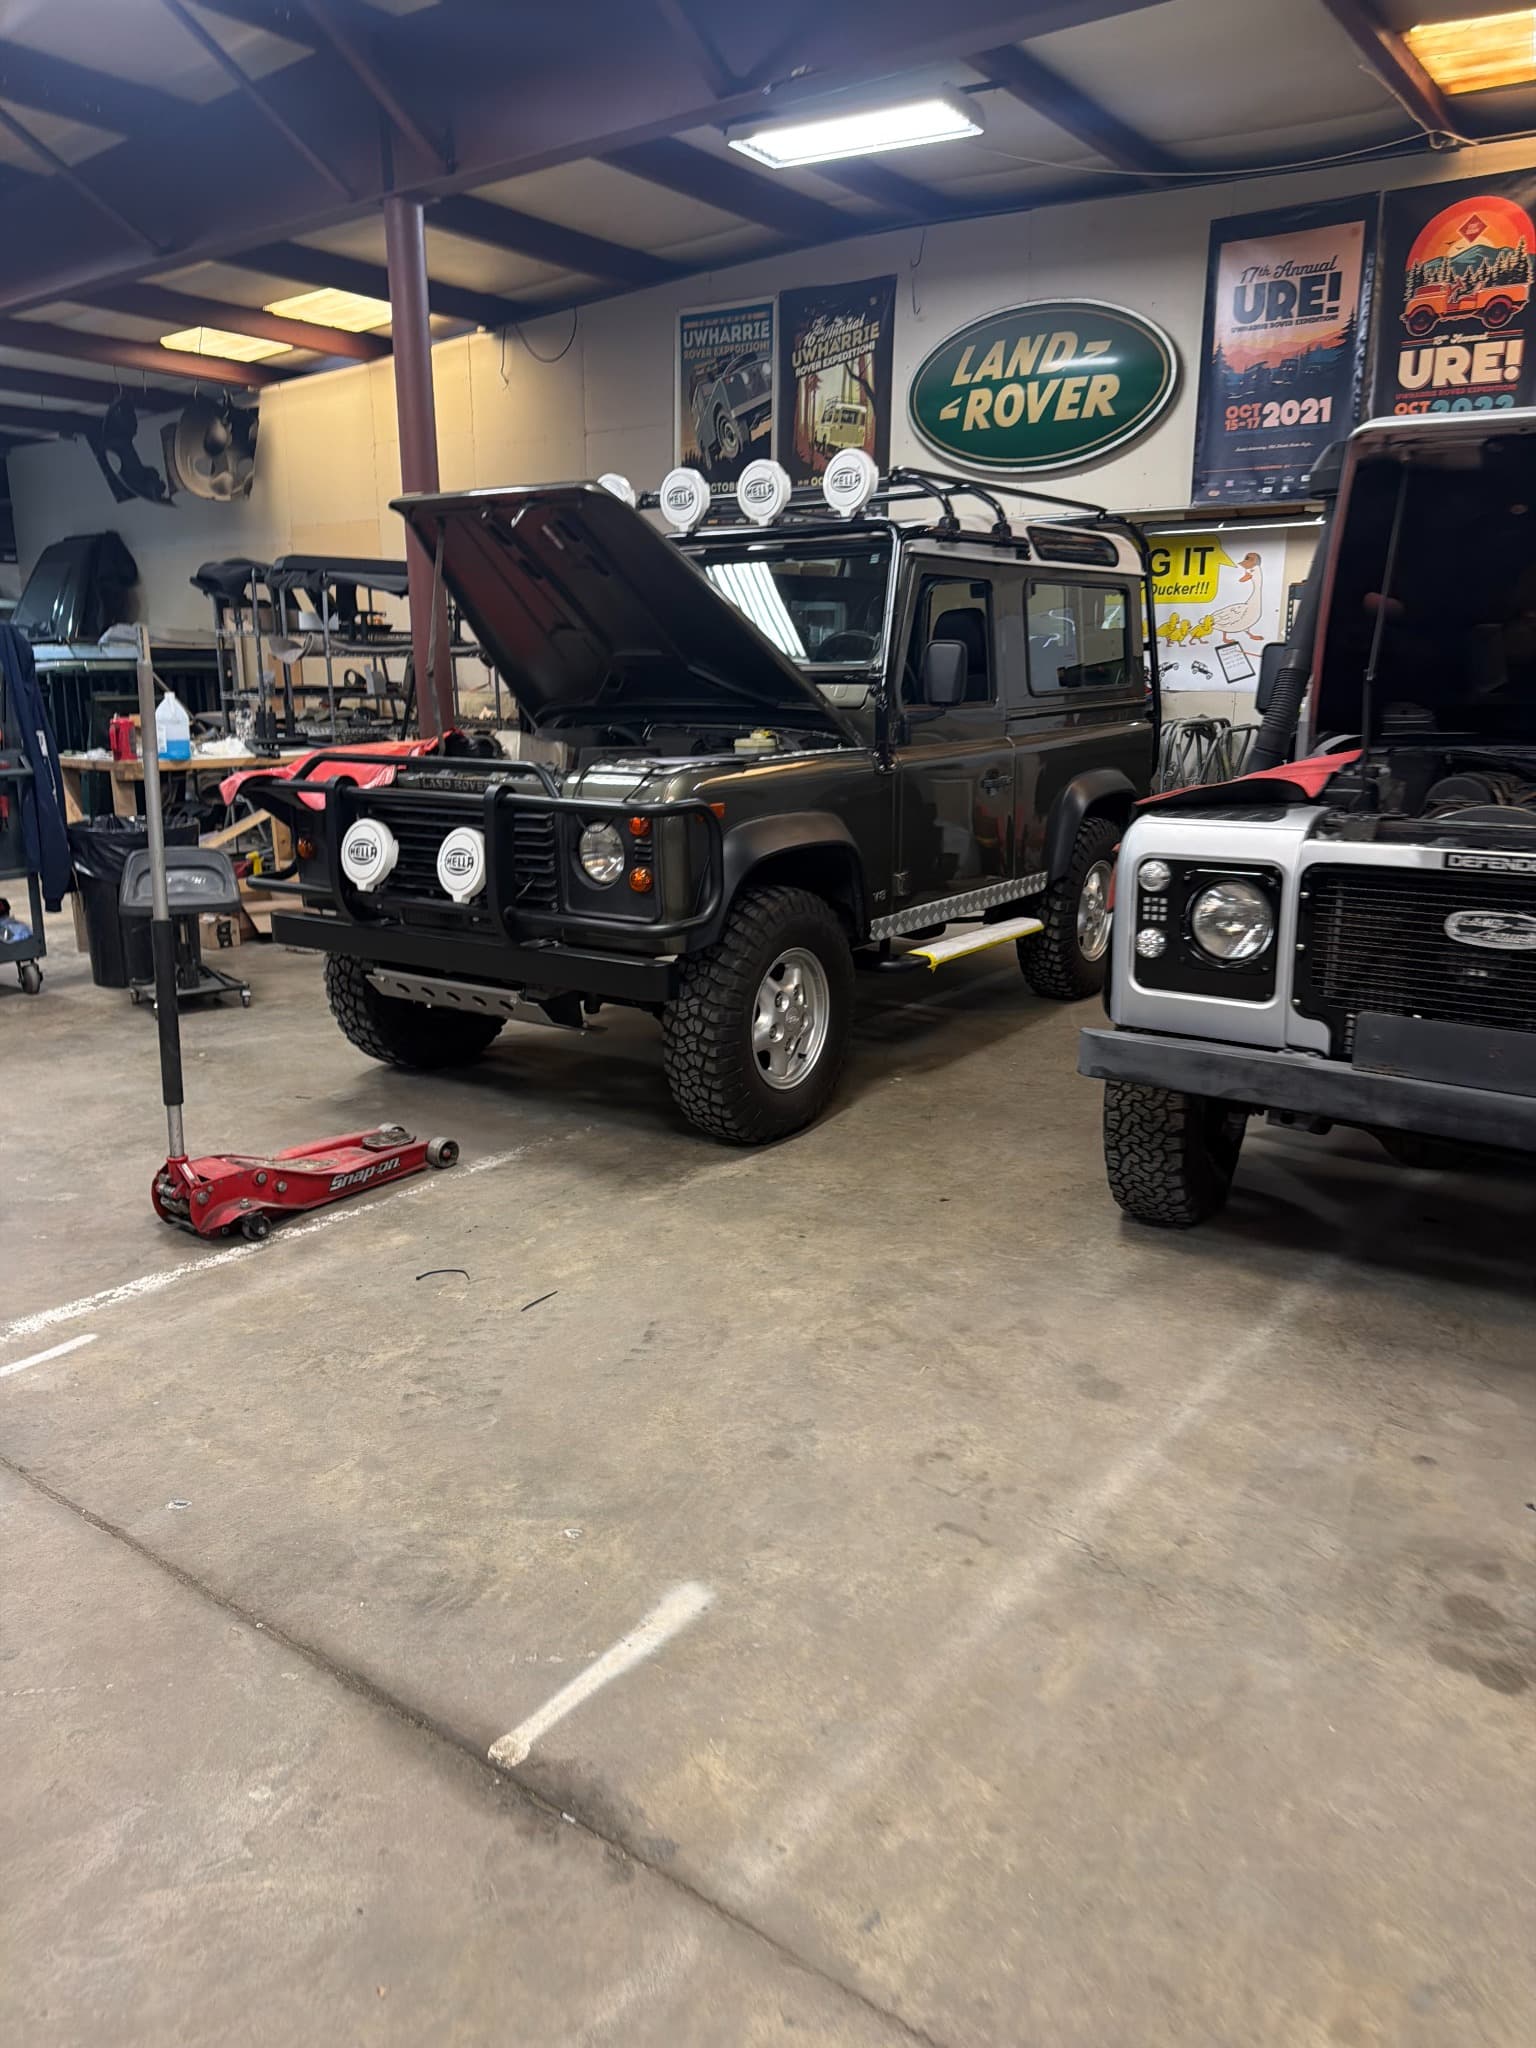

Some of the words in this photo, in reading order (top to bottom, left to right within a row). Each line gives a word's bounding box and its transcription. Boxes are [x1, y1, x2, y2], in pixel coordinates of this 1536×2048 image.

[1240, 265, 1271, 284] 17th
[1274, 254, 1339, 278] Annual
[1232, 272, 1343, 324] URE!
[683, 320, 770, 348] UWHARRIE
[792, 320, 880, 367] UWHARRIE
[795, 361, 822, 377] ROVER
[822, 340, 876, 367] EXPEDITION!
[952, 331, 1078, 387] LAND
[1397, 339, 1525, 391] URE!
[962, 373, 1121, 432] ROVER
[1225, 403, 1262, 419] OCT
[1262, 396, 1333, 428] 2021
[1394, 400, 1432, 415] OCT
[1225, 416, 1261, 431] 15-17
[746, 483, 775, 497] HELLA
[833, 473, 861, 486] HELLA
[669, 491, 695, 505] HELLA
[1184, 546, 1215, 576] IT
[422, 778, 451, 790] LAND
[350, 845, 378, 859] HELLA
[446, 855, 475, 870] HELLA
[329, 1157, 400, 1192] Snap-on
